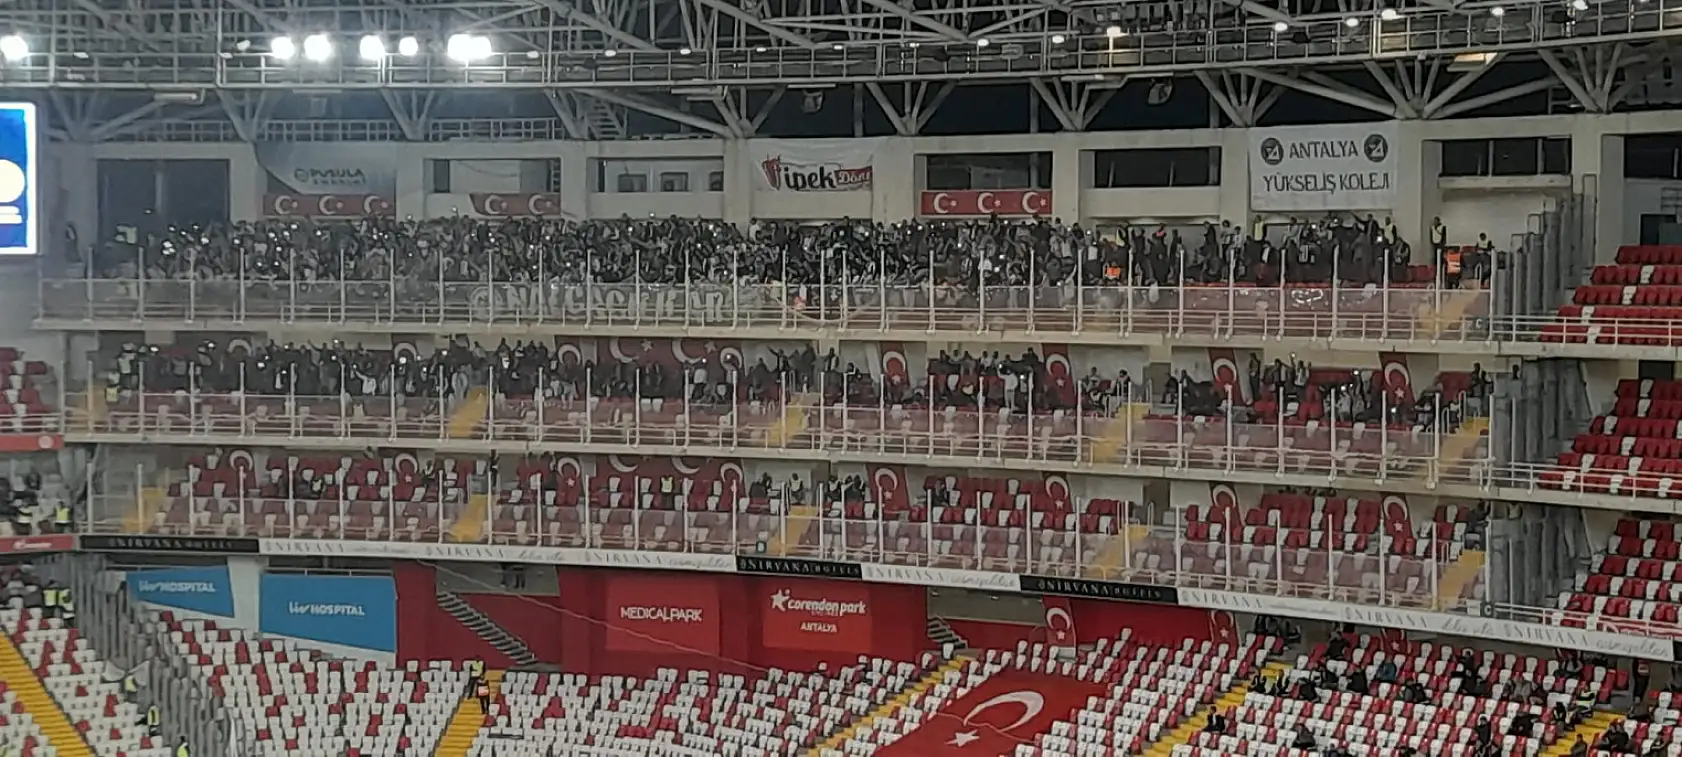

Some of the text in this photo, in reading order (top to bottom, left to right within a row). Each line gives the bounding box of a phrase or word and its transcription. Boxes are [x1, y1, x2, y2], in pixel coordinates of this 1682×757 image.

[1289, 141, 1359, 158] ANTALYA
[747, 558, 810, 572] NIRVANA
[1046, 579, 1109, 595] NIRVANA
[788, 597, 839, 611] corendon
[840, 600, 867, 617] park
[1191, 590, 1263, 608] NIRVANA
[311, 603, 367, 616] HOSPITAL
[800, 622, 838, 633] ANTALYA
